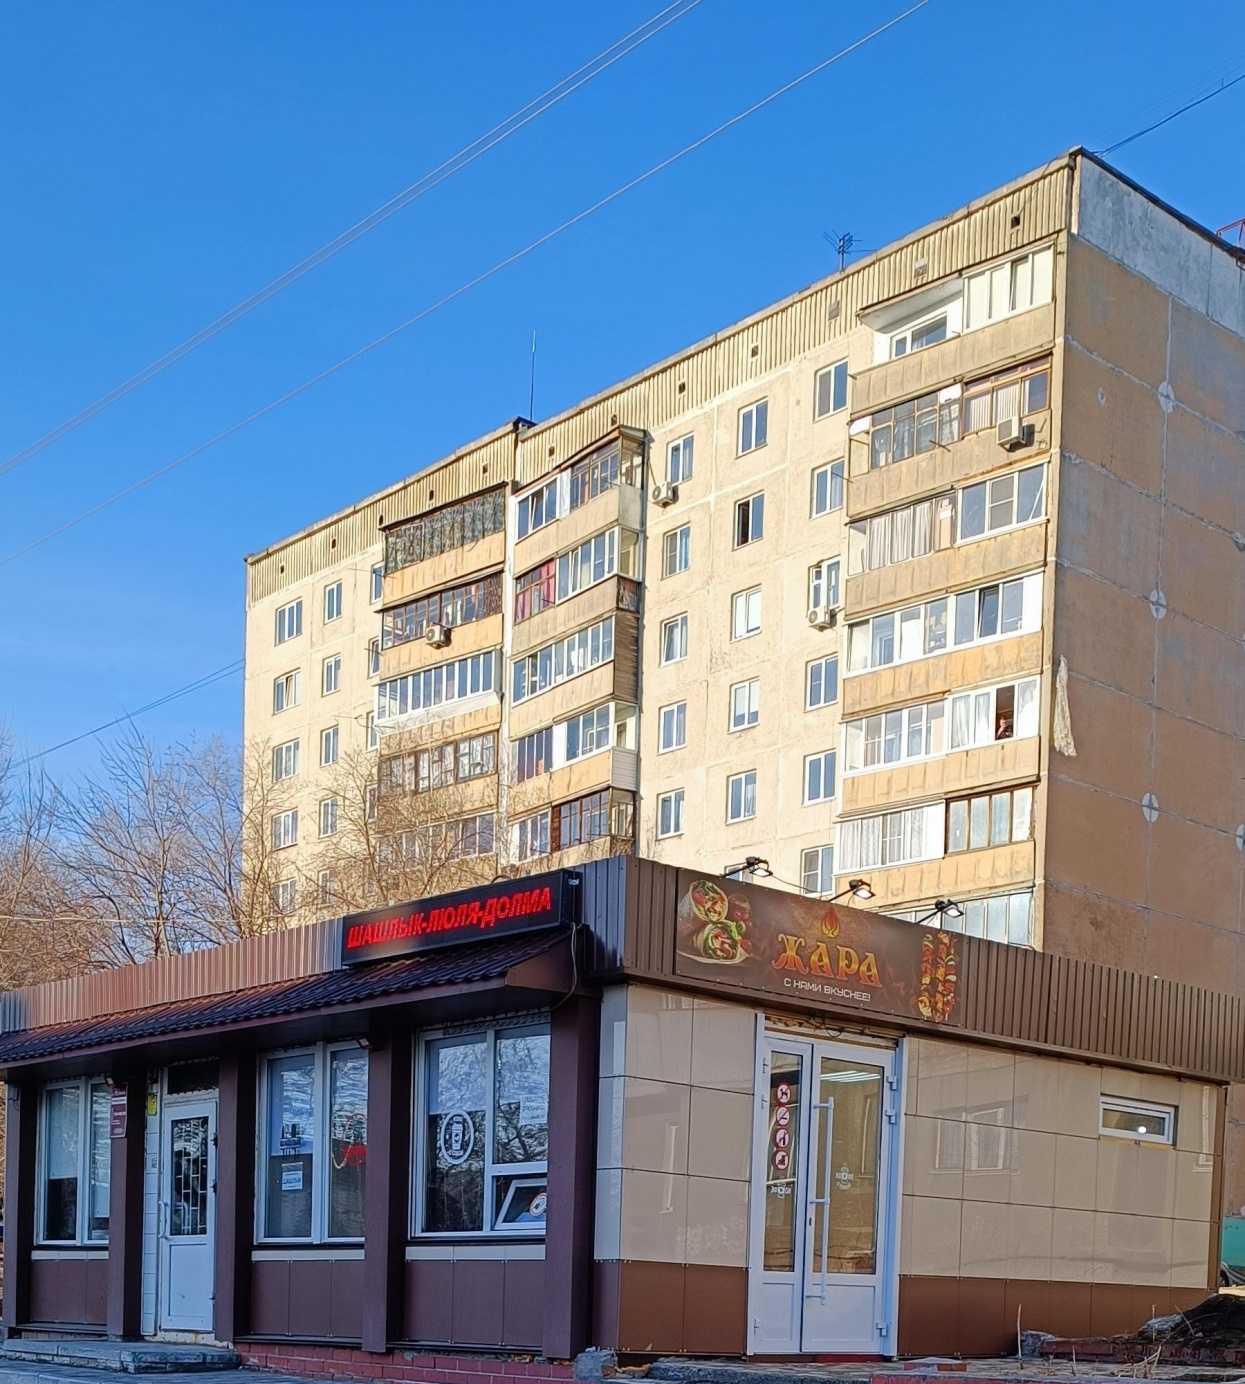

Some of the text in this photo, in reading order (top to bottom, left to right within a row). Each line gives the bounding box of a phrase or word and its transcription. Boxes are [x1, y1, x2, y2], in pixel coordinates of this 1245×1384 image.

[347, 886, 552, 948] ШАШЛЫК-ЛЮЛЯ-ДОЛМА
[772, 933, 882, 988] ЖАРА
[783, 978, 871, 1002] С НАМИ ВКУСНЕЕ!
